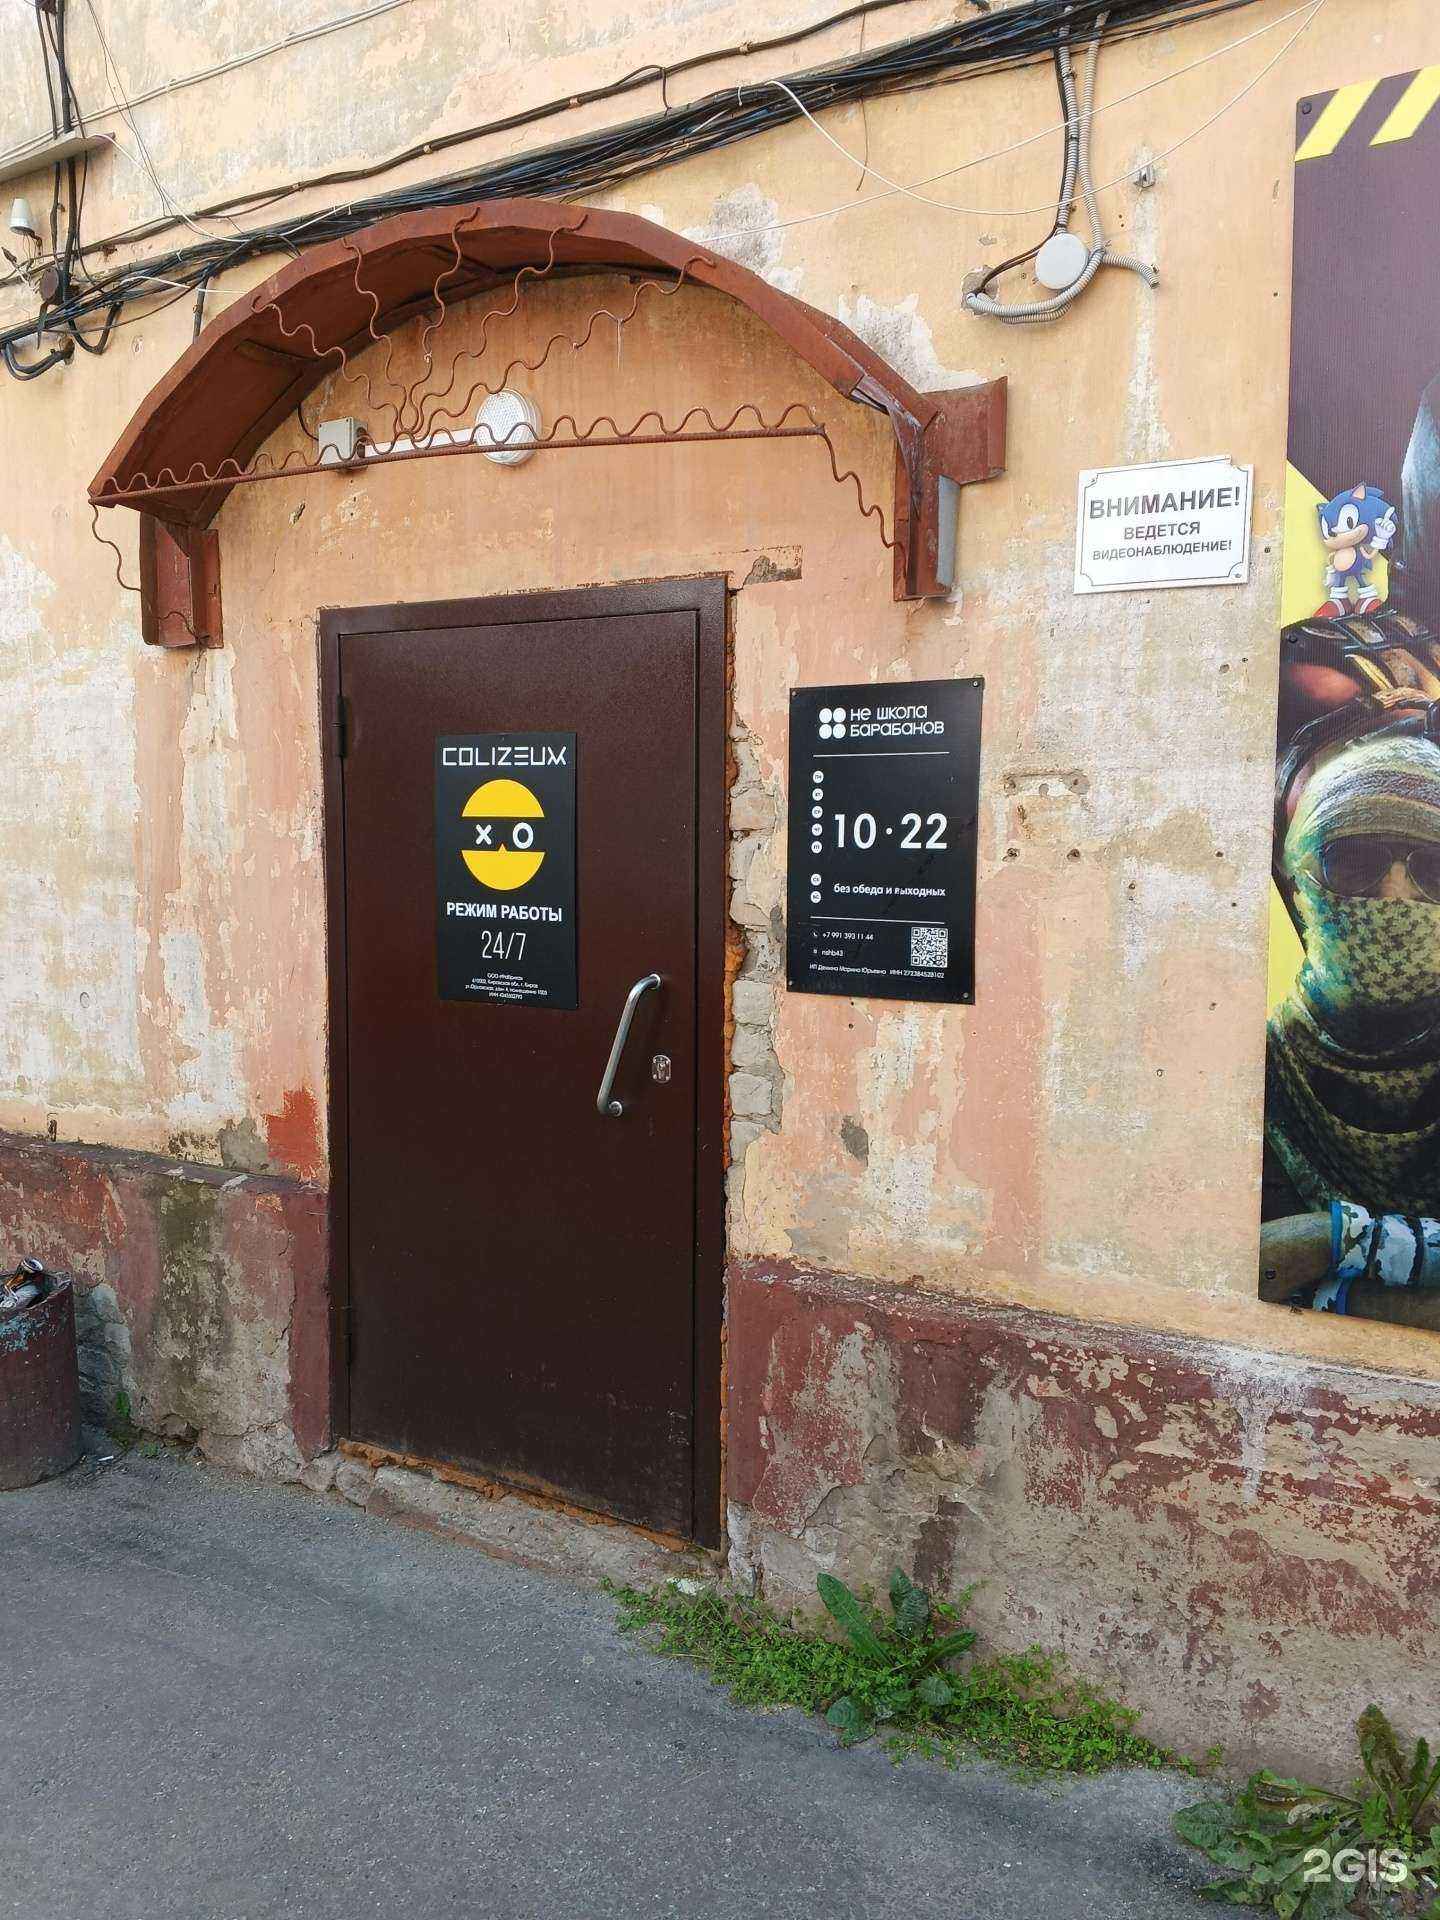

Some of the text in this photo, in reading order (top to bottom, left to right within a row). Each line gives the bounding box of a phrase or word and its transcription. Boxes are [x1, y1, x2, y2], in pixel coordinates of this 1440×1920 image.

[1089, 486, 1241, 519] ВНИМАНИЕ!
[1123, 521, 1201, 541] ВЕДЕТСЯ
[1092, 540, 1232, 561] ВИДЕОНАБЛЮДЕНИЕ!
[876, 705, 928, 720] школа
[442, 746, 567, 766] COLIZEUM
[833, 883, 946, 898] без обеда и выходных
[446, 901, 563, 922] РЕЖИМ РАБОТЫ
[481, 930, 527, 961] 24/7
